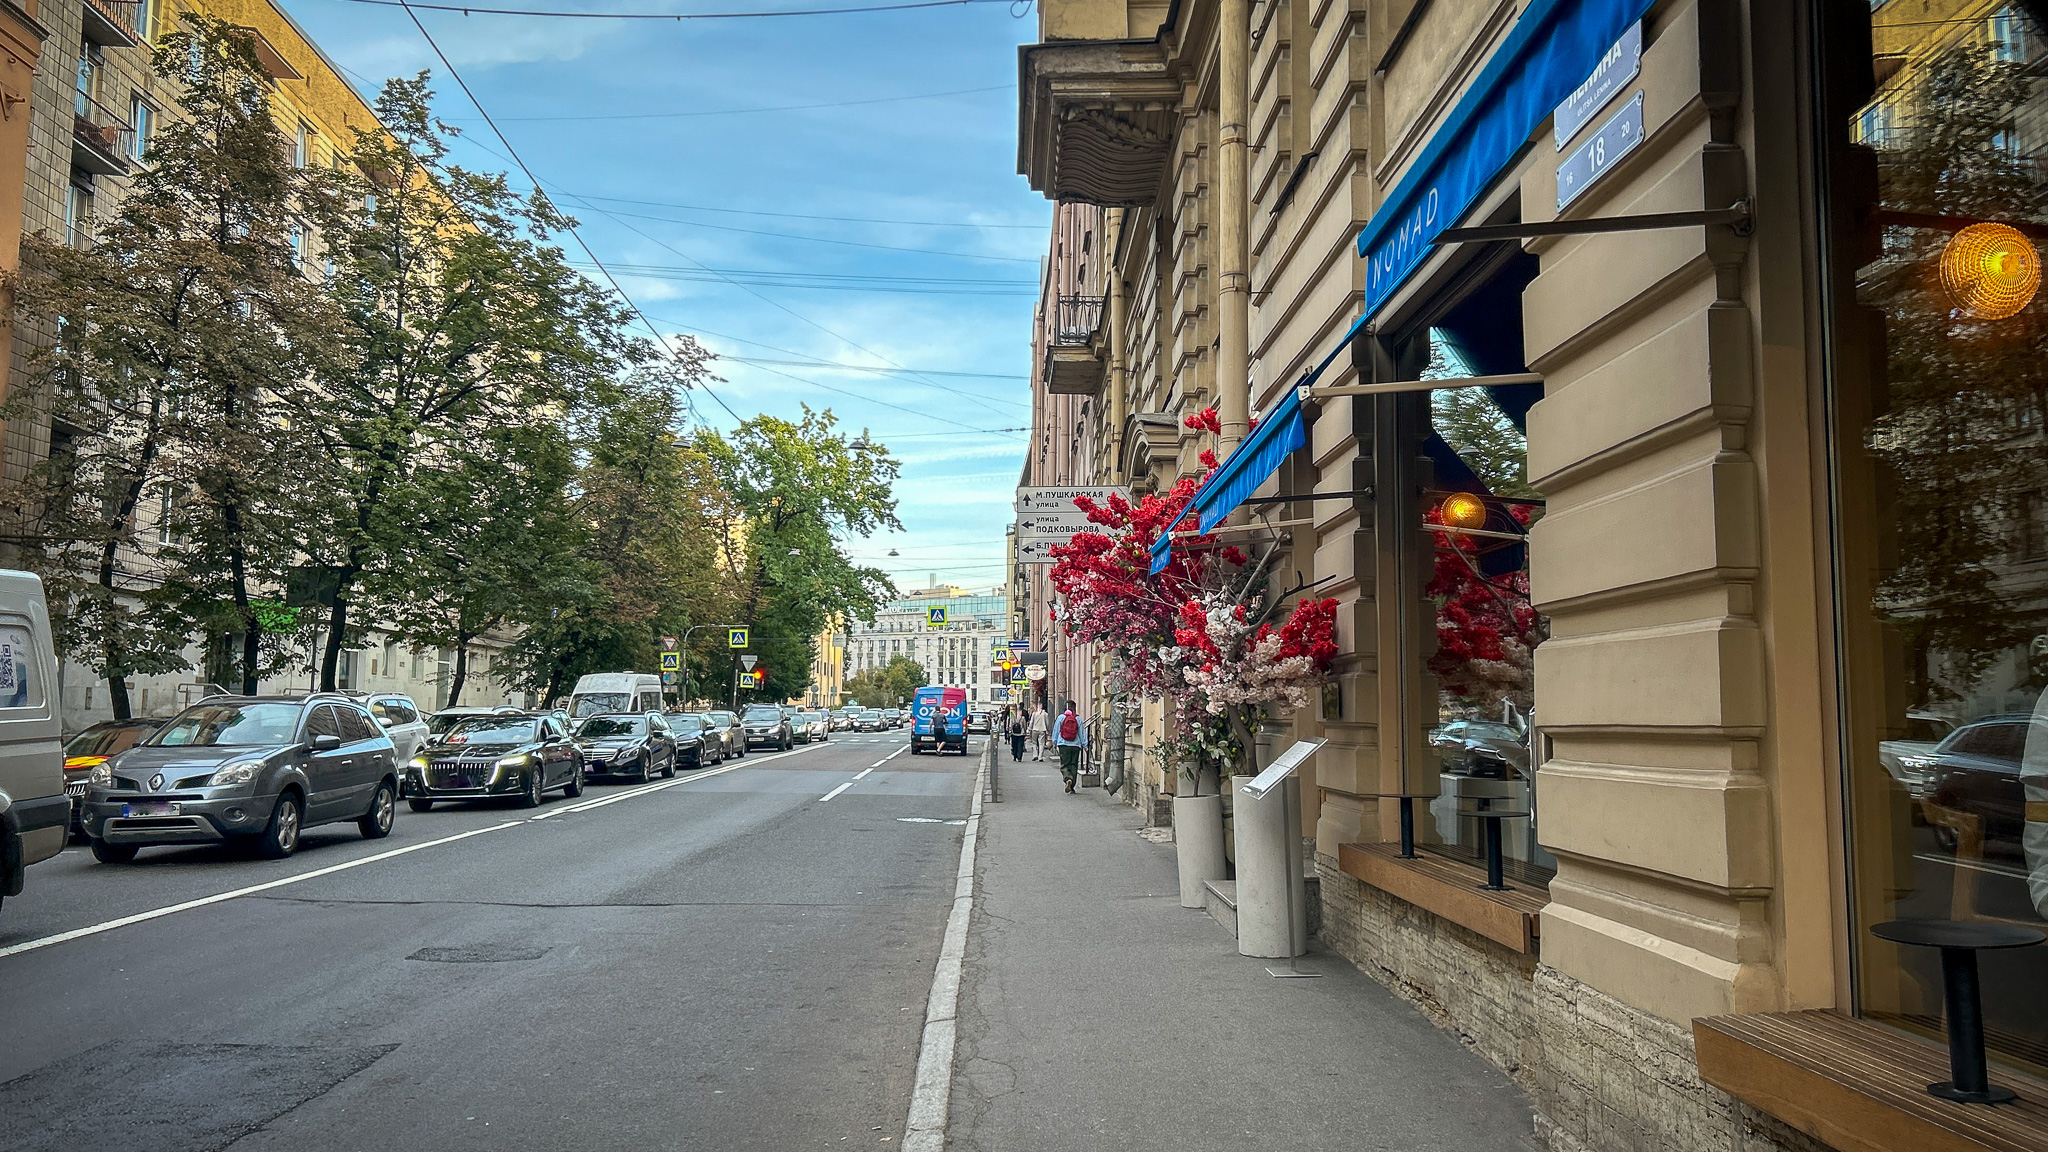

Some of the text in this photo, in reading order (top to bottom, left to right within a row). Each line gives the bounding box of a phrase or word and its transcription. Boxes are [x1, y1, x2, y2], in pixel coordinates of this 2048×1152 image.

[1594, 78, 1612, 101] LENINA
[1588, 136, 1605, 173] 18
[1621, 120, 1630, 138] 20
[1372, 187, 1438, 289] NOMAD
[1036, 525, 1100, 534] ПОДКОВЫРОВА
[919, 706, 960, 717] OZON
